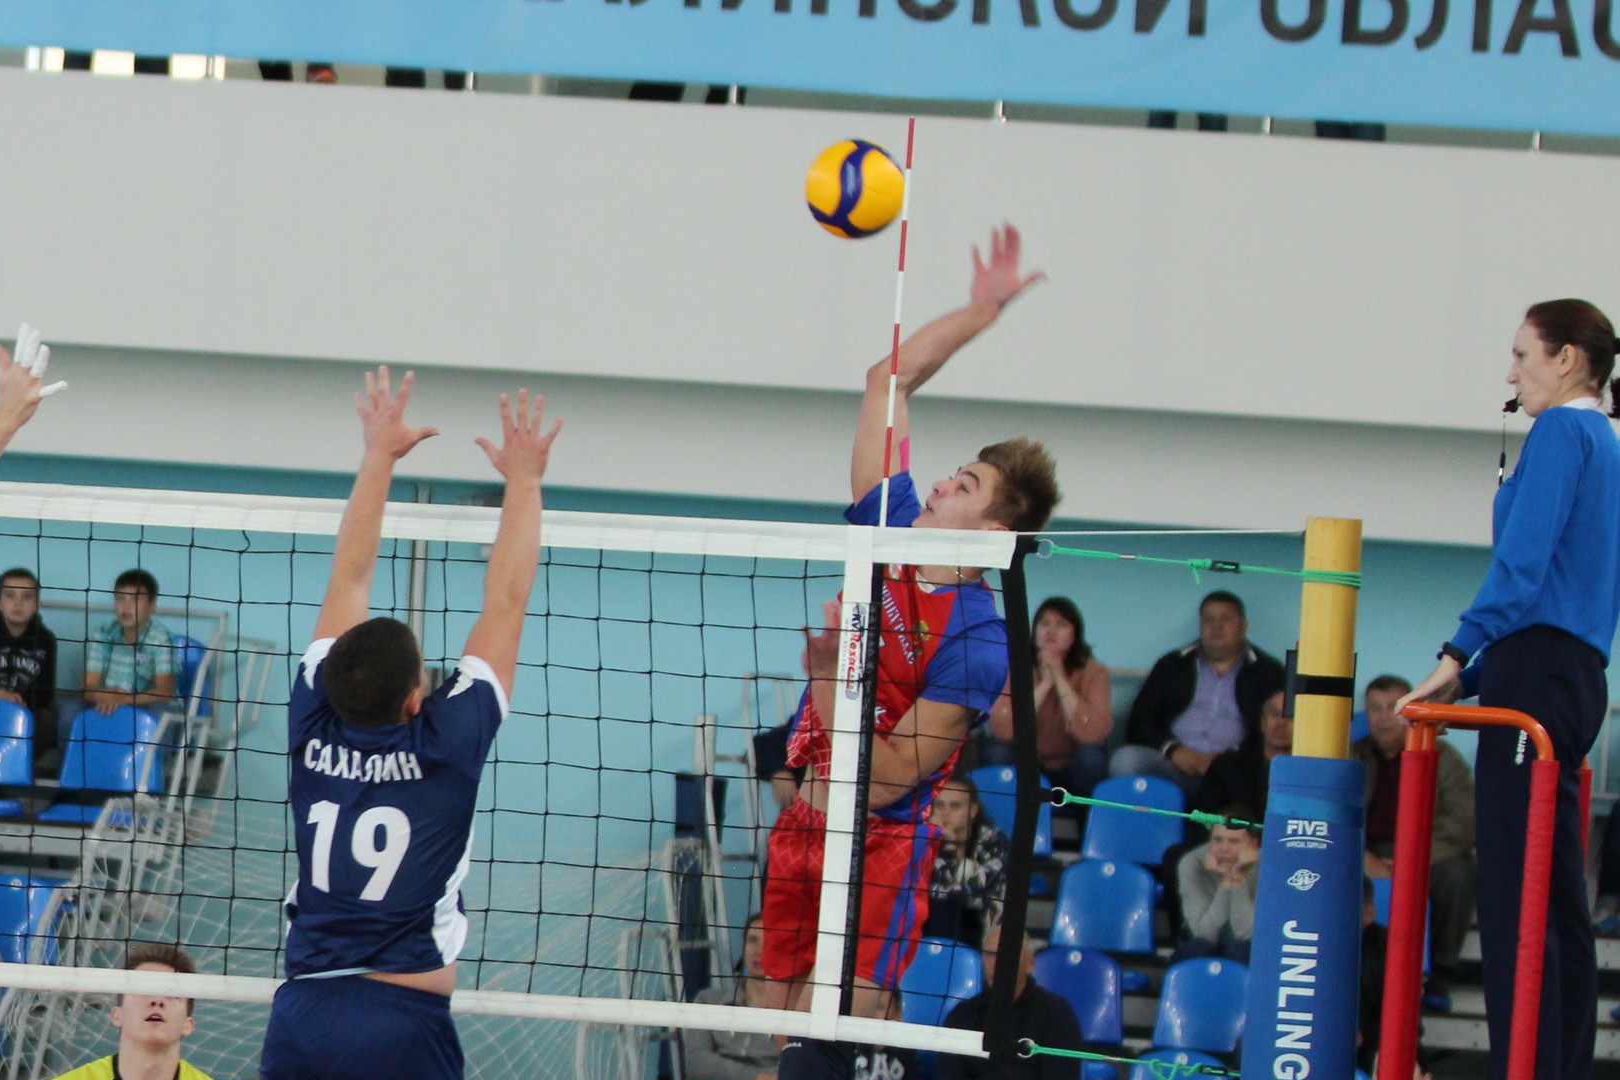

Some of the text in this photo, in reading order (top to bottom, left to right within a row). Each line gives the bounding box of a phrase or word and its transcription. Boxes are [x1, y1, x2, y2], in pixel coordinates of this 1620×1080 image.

[304, 738, 423, 783] САХАЛИН
[307, 800, 411, 901] 19
[1287, 819, 1329, 836] FIVB
[1273, 920, 1319, 1080] JINLING
